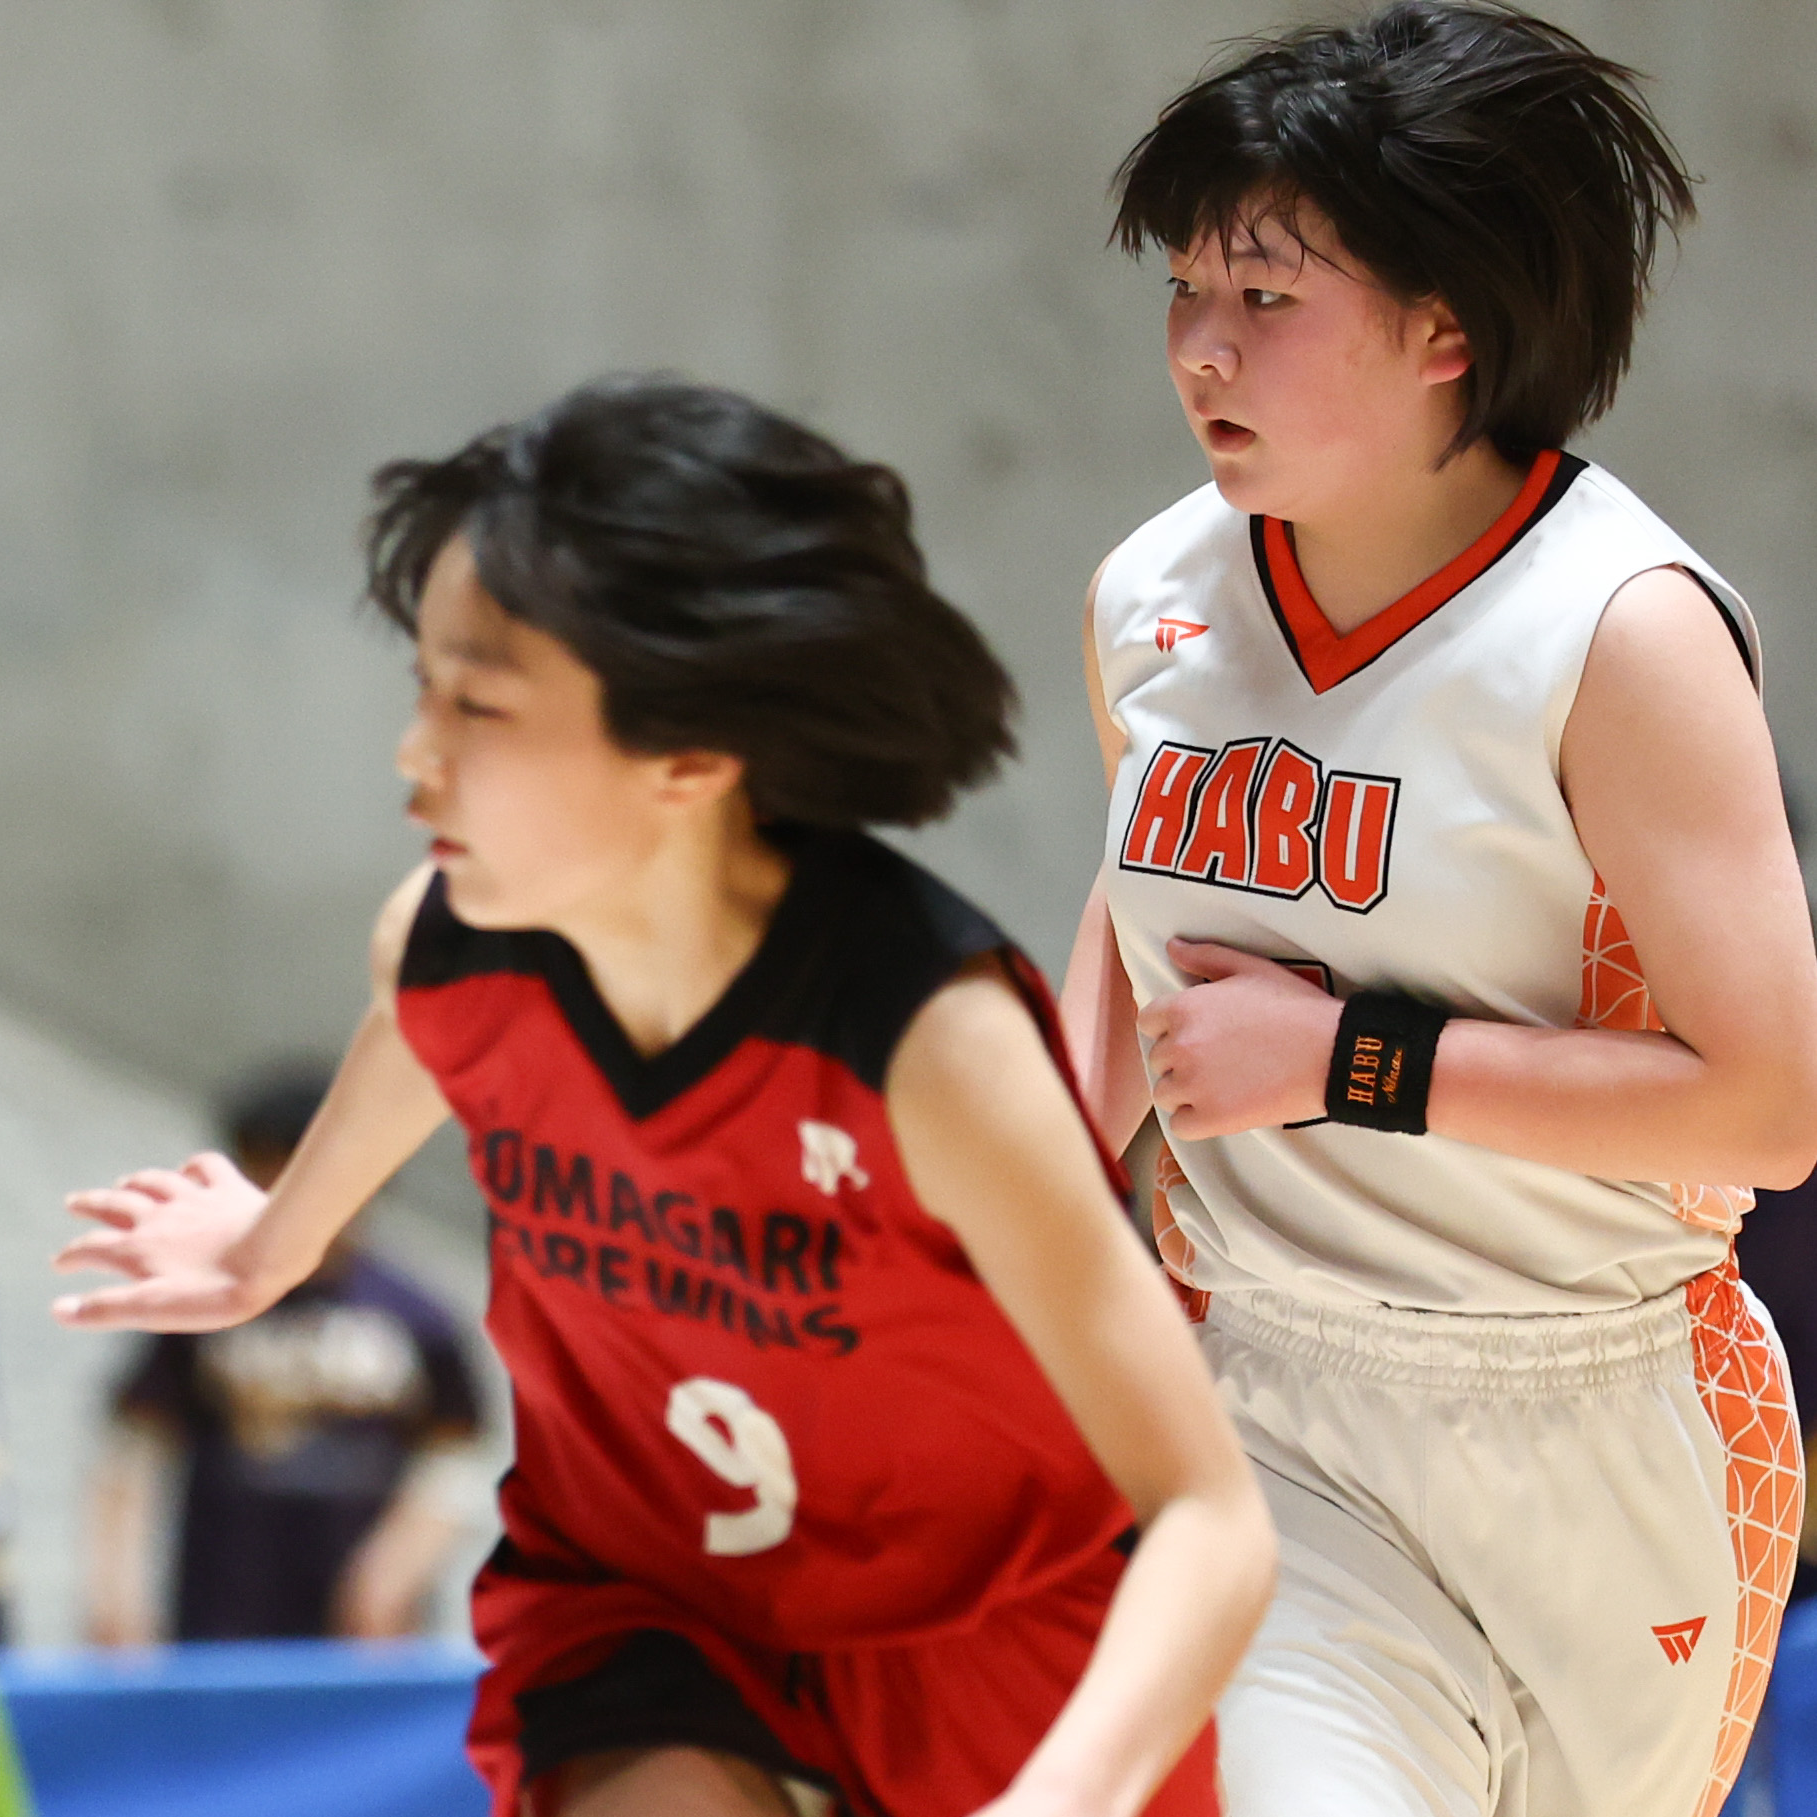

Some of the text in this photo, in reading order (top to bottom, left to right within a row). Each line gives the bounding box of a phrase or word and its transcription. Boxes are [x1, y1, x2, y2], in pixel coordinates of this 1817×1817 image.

[1119, 737, 1400, 914] HABU
[1347, 1035, 1383, 1106] HABU
[483, 1129, 842, 1294] OMAGARI
[665, 1376, 799, 1557] 9
